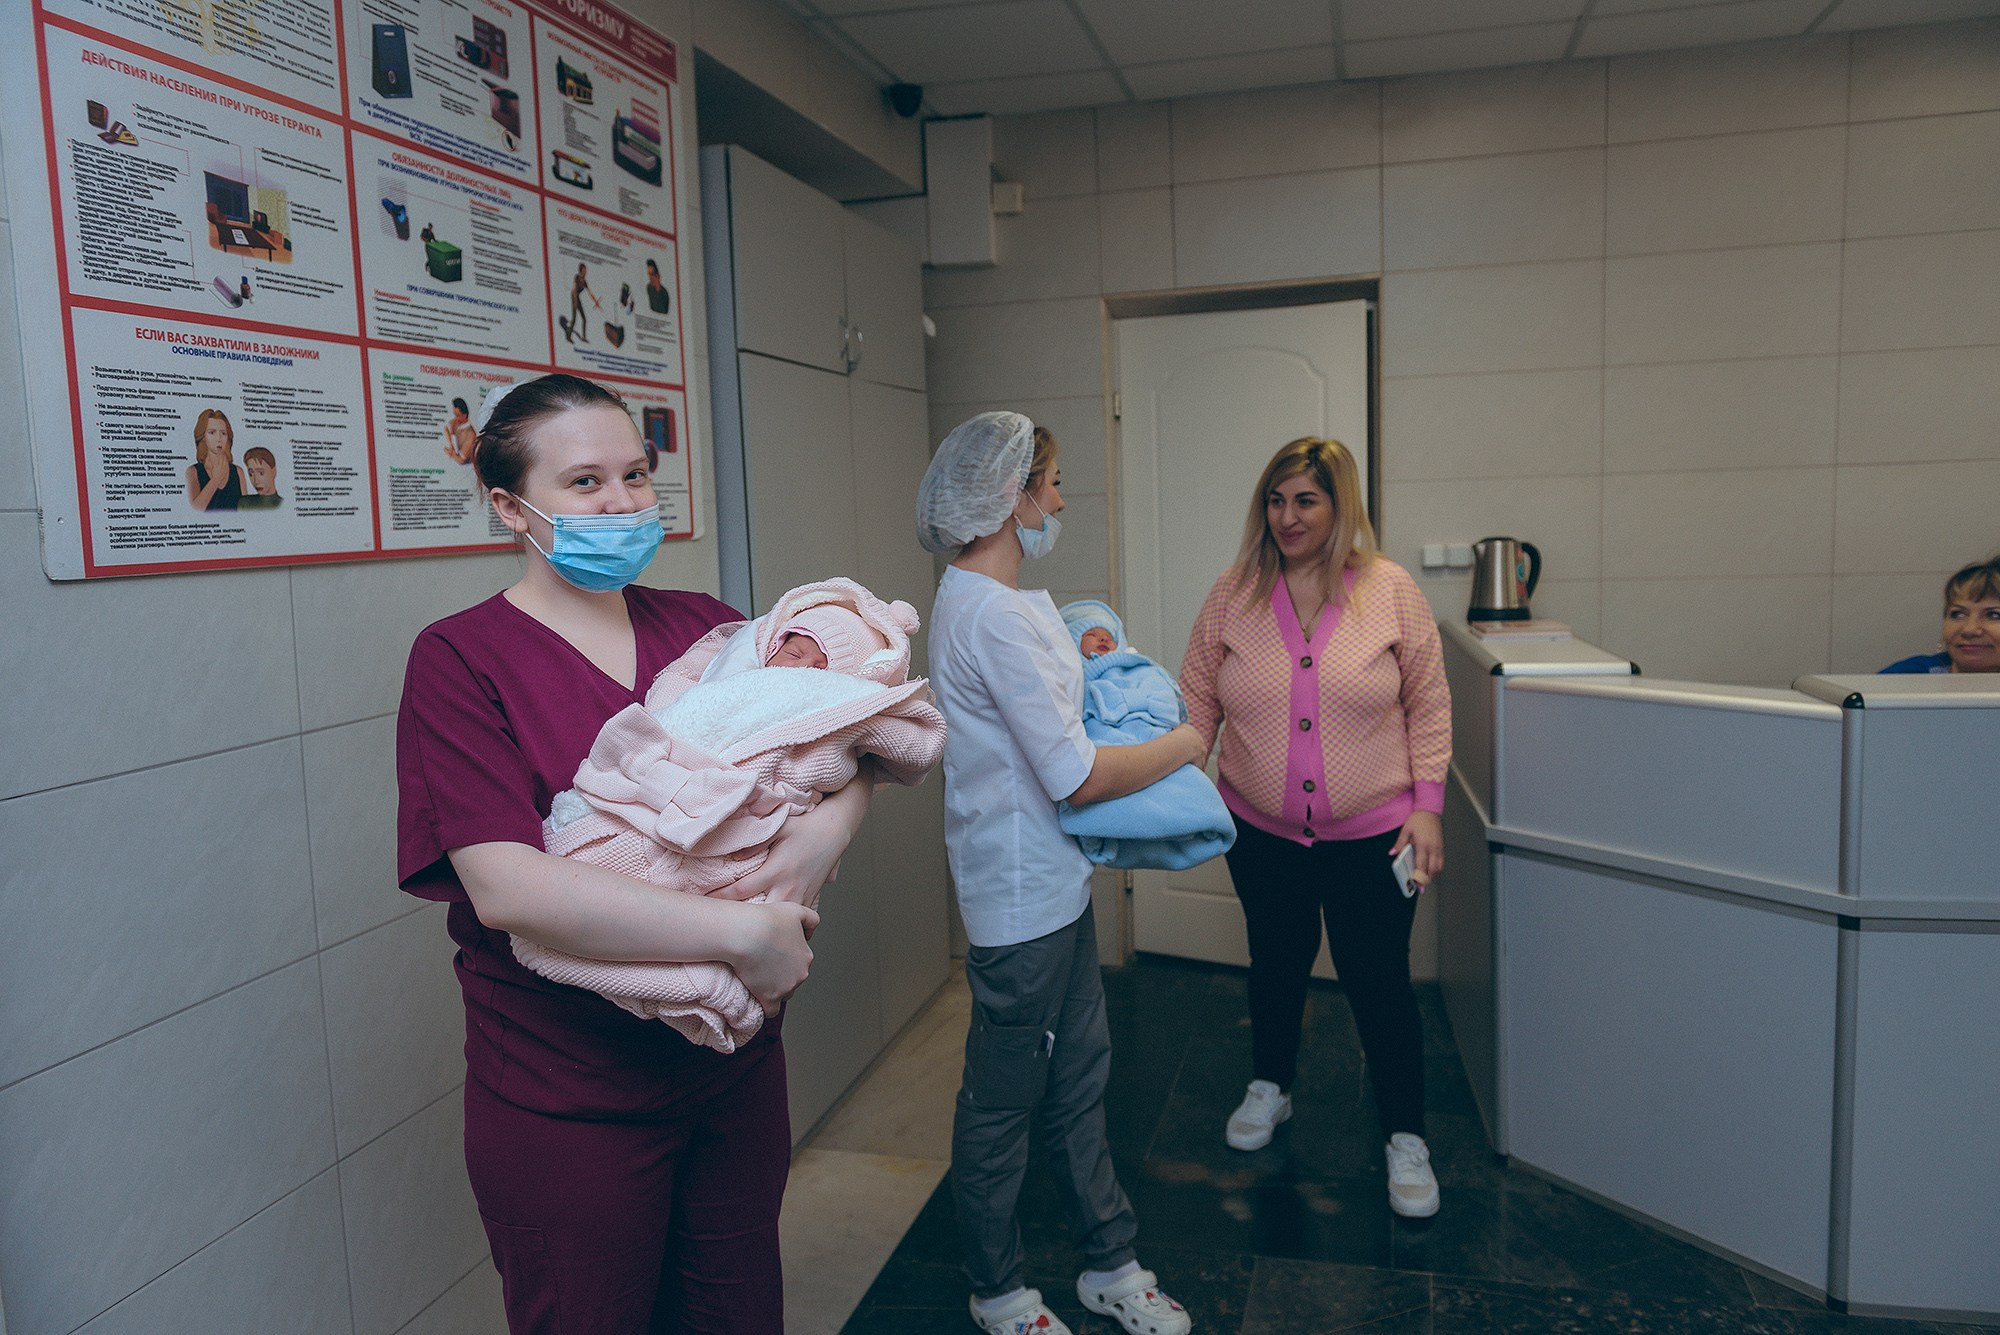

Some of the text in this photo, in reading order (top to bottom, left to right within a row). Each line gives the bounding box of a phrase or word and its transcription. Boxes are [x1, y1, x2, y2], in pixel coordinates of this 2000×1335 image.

[558, 0, 625, 40] ОРИЗМУ
[82, 49, 322, 138] ДЕЙСТВИЯ НАСЕЛЕНИЯ ПРИ УГРОЗЕ ТЕРАКТА
[392, 153, 511, 200] ОБЯЗАННОСТИ ДОЛЖНОСТНЫХ ЛИЦ
[135, 328, 319, 360] ЕСЛИ ВАС ЗАХВАТИЛИ В ЗАЛОЖНИКИ
[172, 346, 293, 366] ОСНОВНЫЕ ПРАВИЛА ПОВЕДЕНИЯ
[420, 364, 514, 384] ПОВЕДЕНИЕ ПОСТРАДАВШИХ
